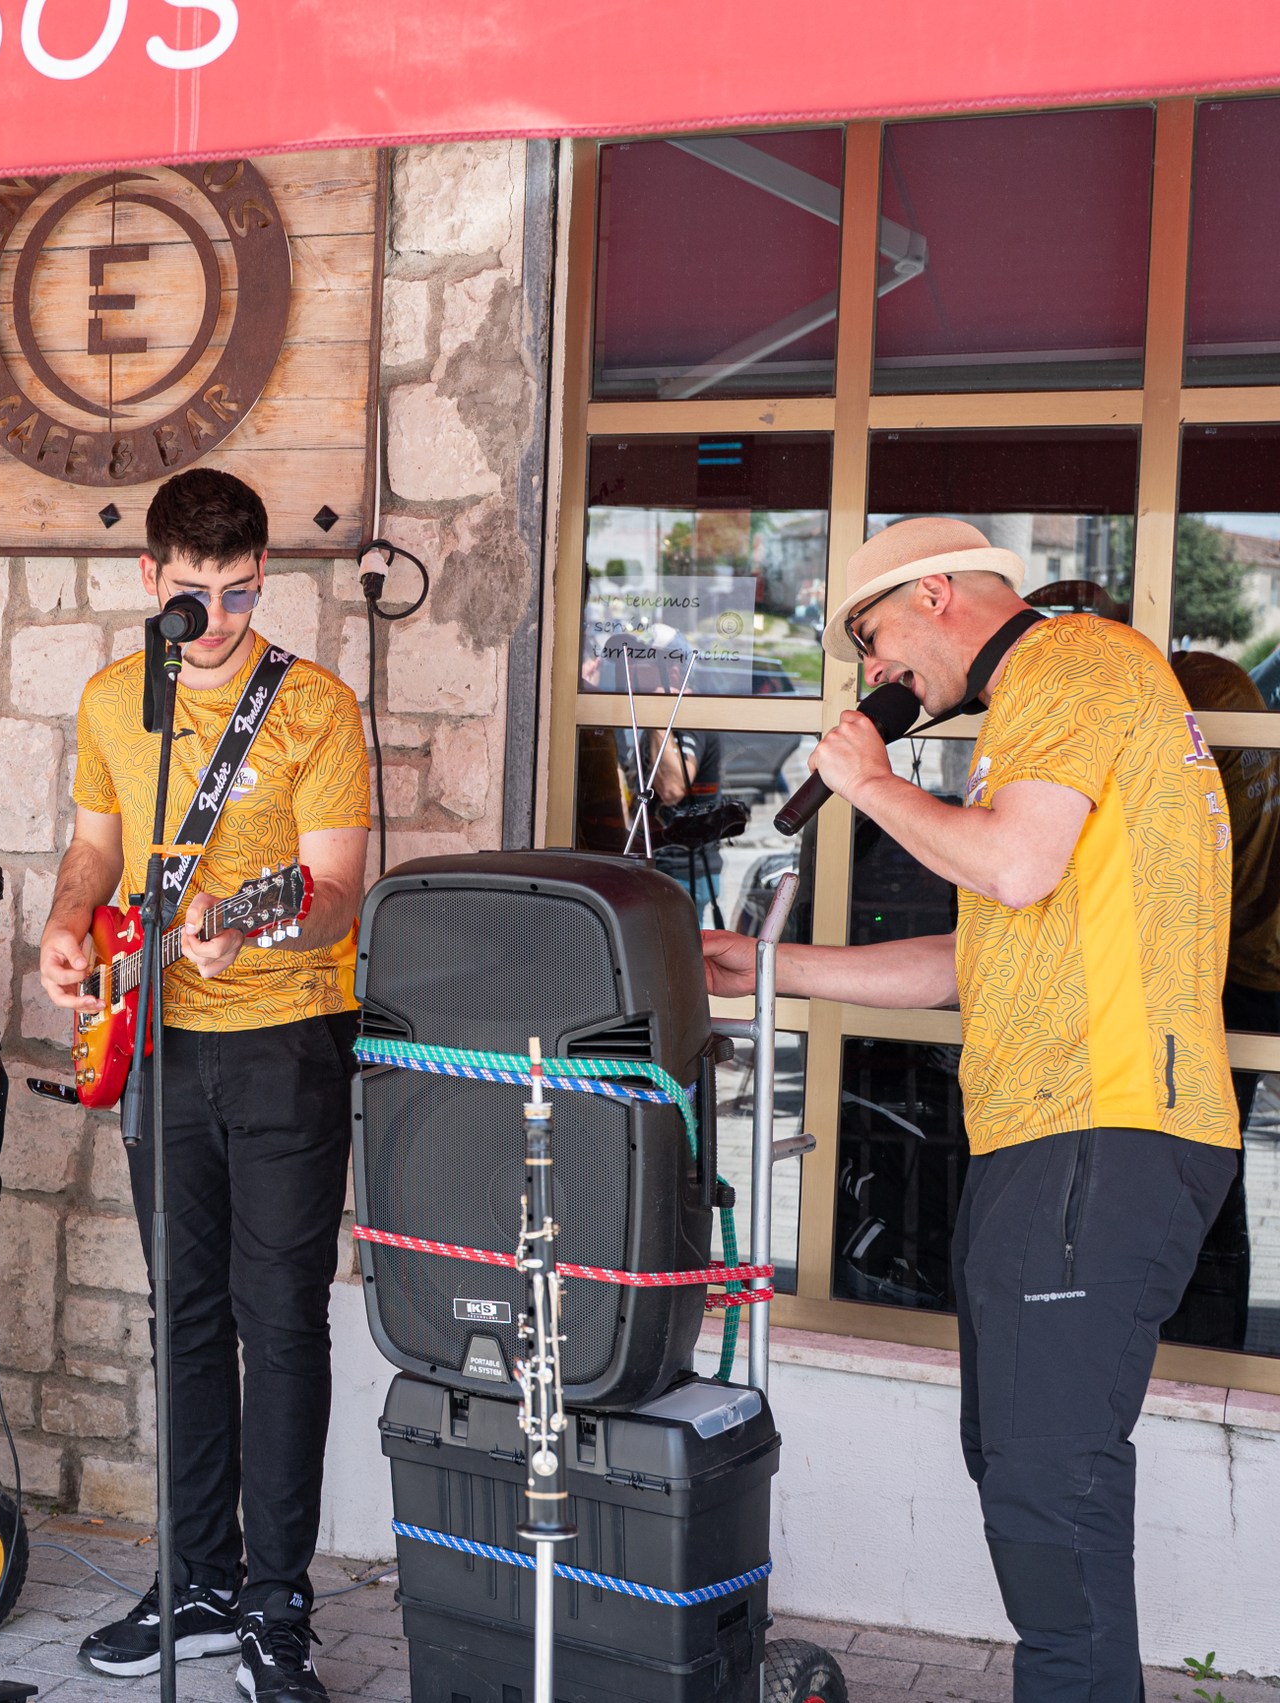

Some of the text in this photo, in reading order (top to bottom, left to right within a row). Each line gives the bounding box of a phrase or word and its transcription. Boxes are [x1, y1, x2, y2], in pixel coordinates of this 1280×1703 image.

[88, 245, 150, 355] E
[153, 383, 240, 467] BAR
[624, 593, 701, 609] tenemos
[234, 686, 268, 734] Fender
[198, 762, 232, 812] Fender
[469, 1364, 502, 1376] PA SYSTEM
[470, 1356, 500, 1368] PORTABLE
